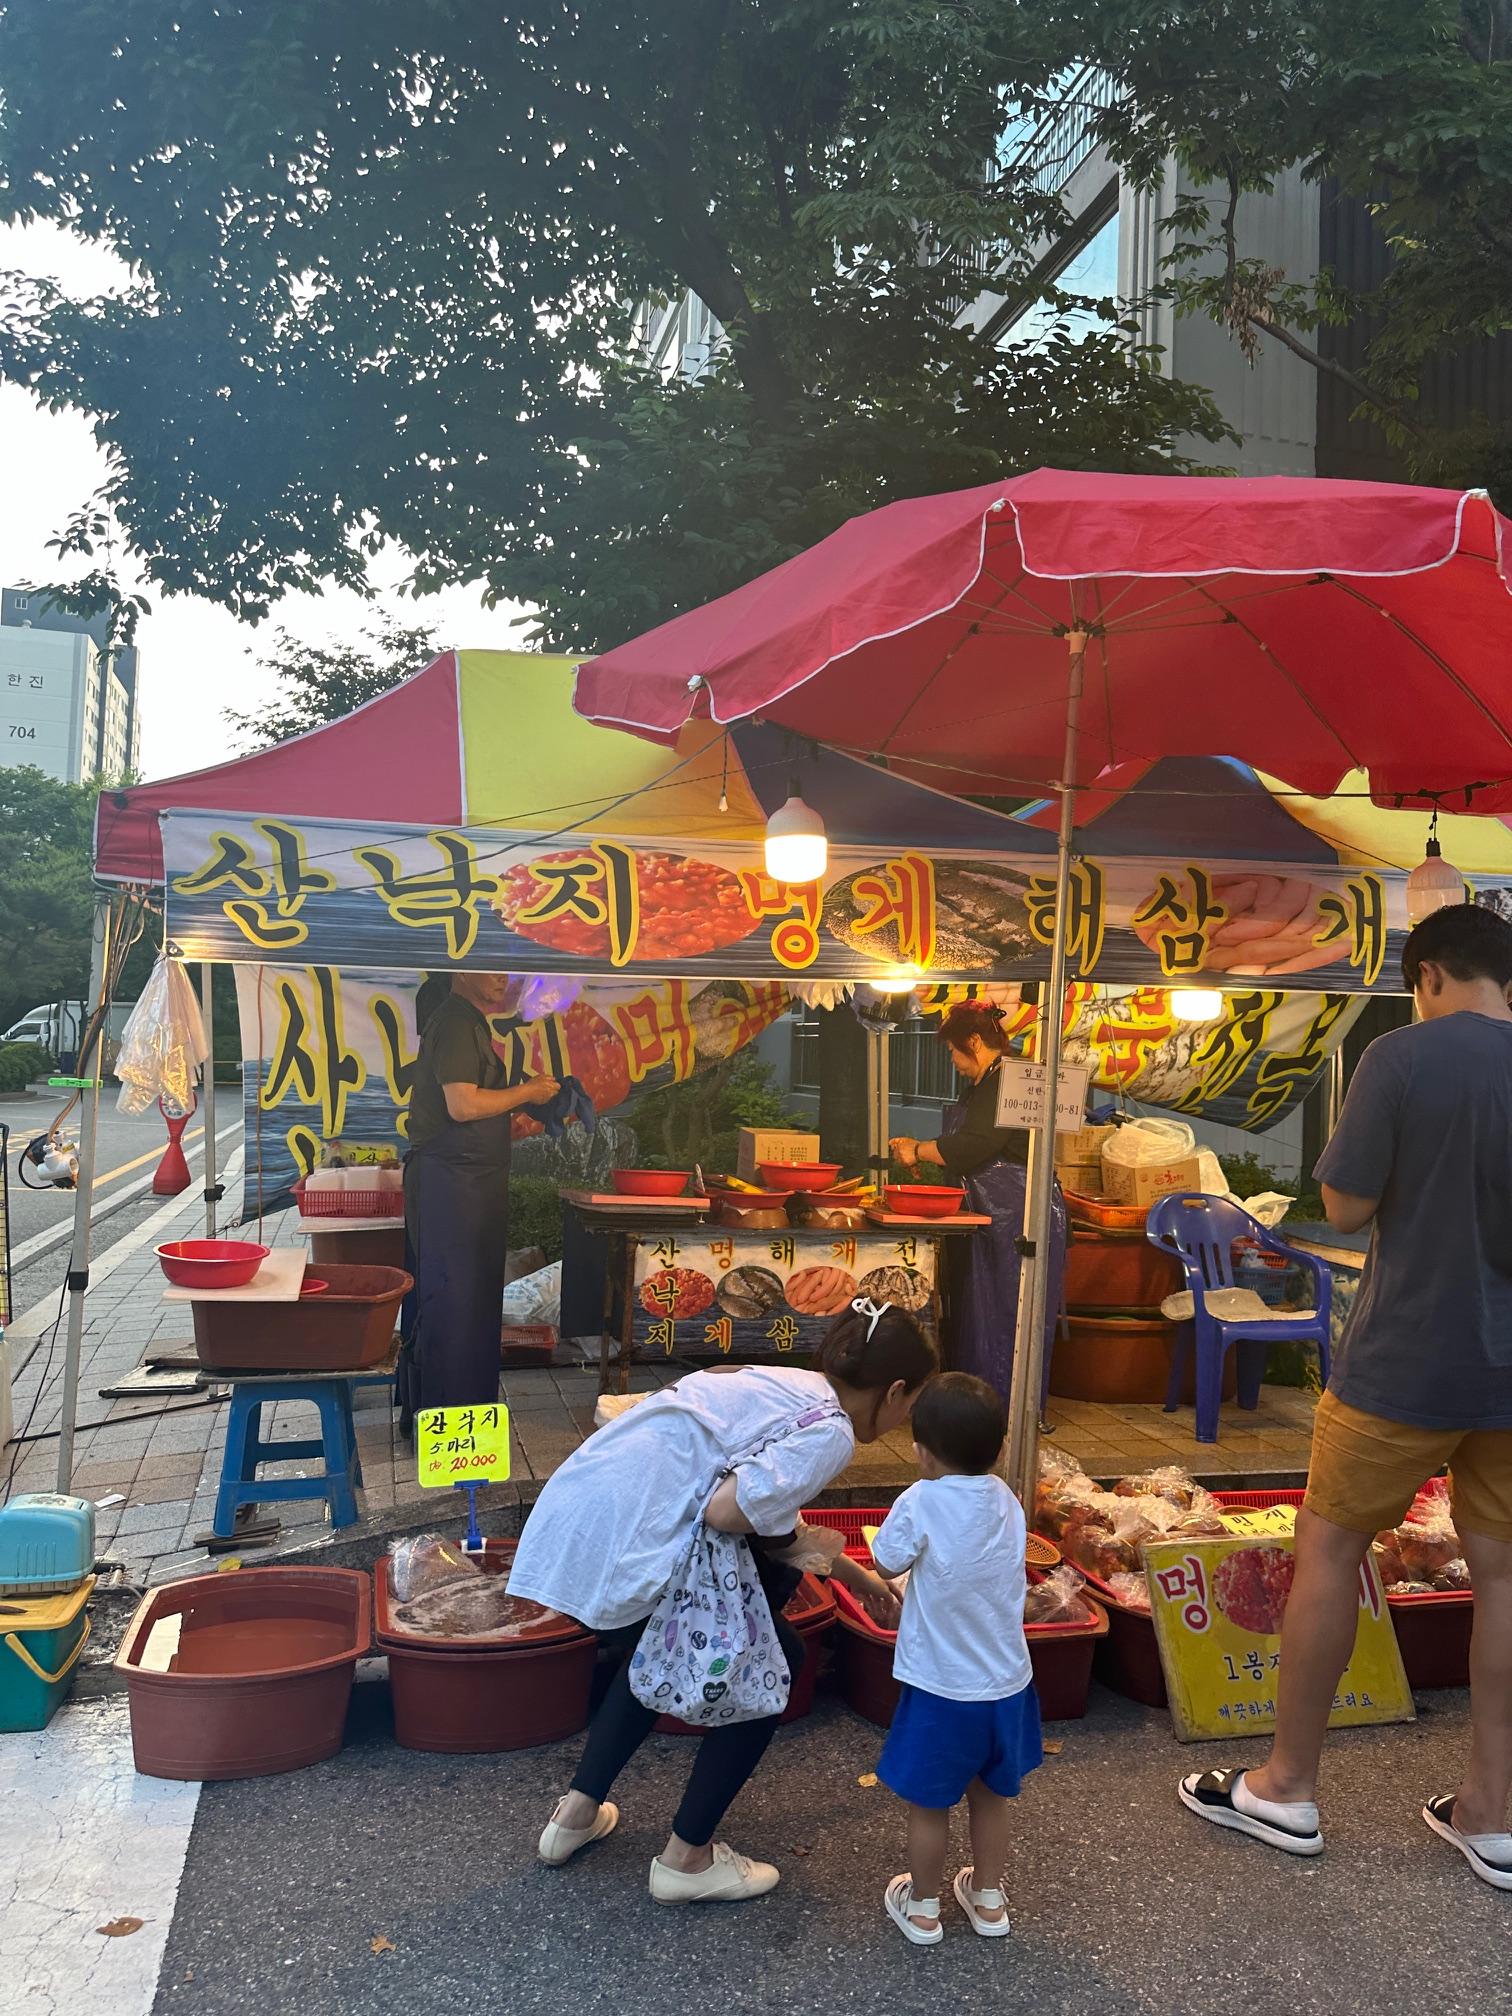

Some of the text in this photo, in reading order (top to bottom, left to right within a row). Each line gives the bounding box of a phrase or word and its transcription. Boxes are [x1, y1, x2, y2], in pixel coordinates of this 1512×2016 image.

[8, 674, 43, 688] 한진
[9, 725, 36, 739] 704
[173, 818, 638, 967] 산낙지
[645, 1236, 680, 1355] 산낙지
[704, 1236, 734, 1354] 멍게
[766, 1235, 799, 1352] 해삼
